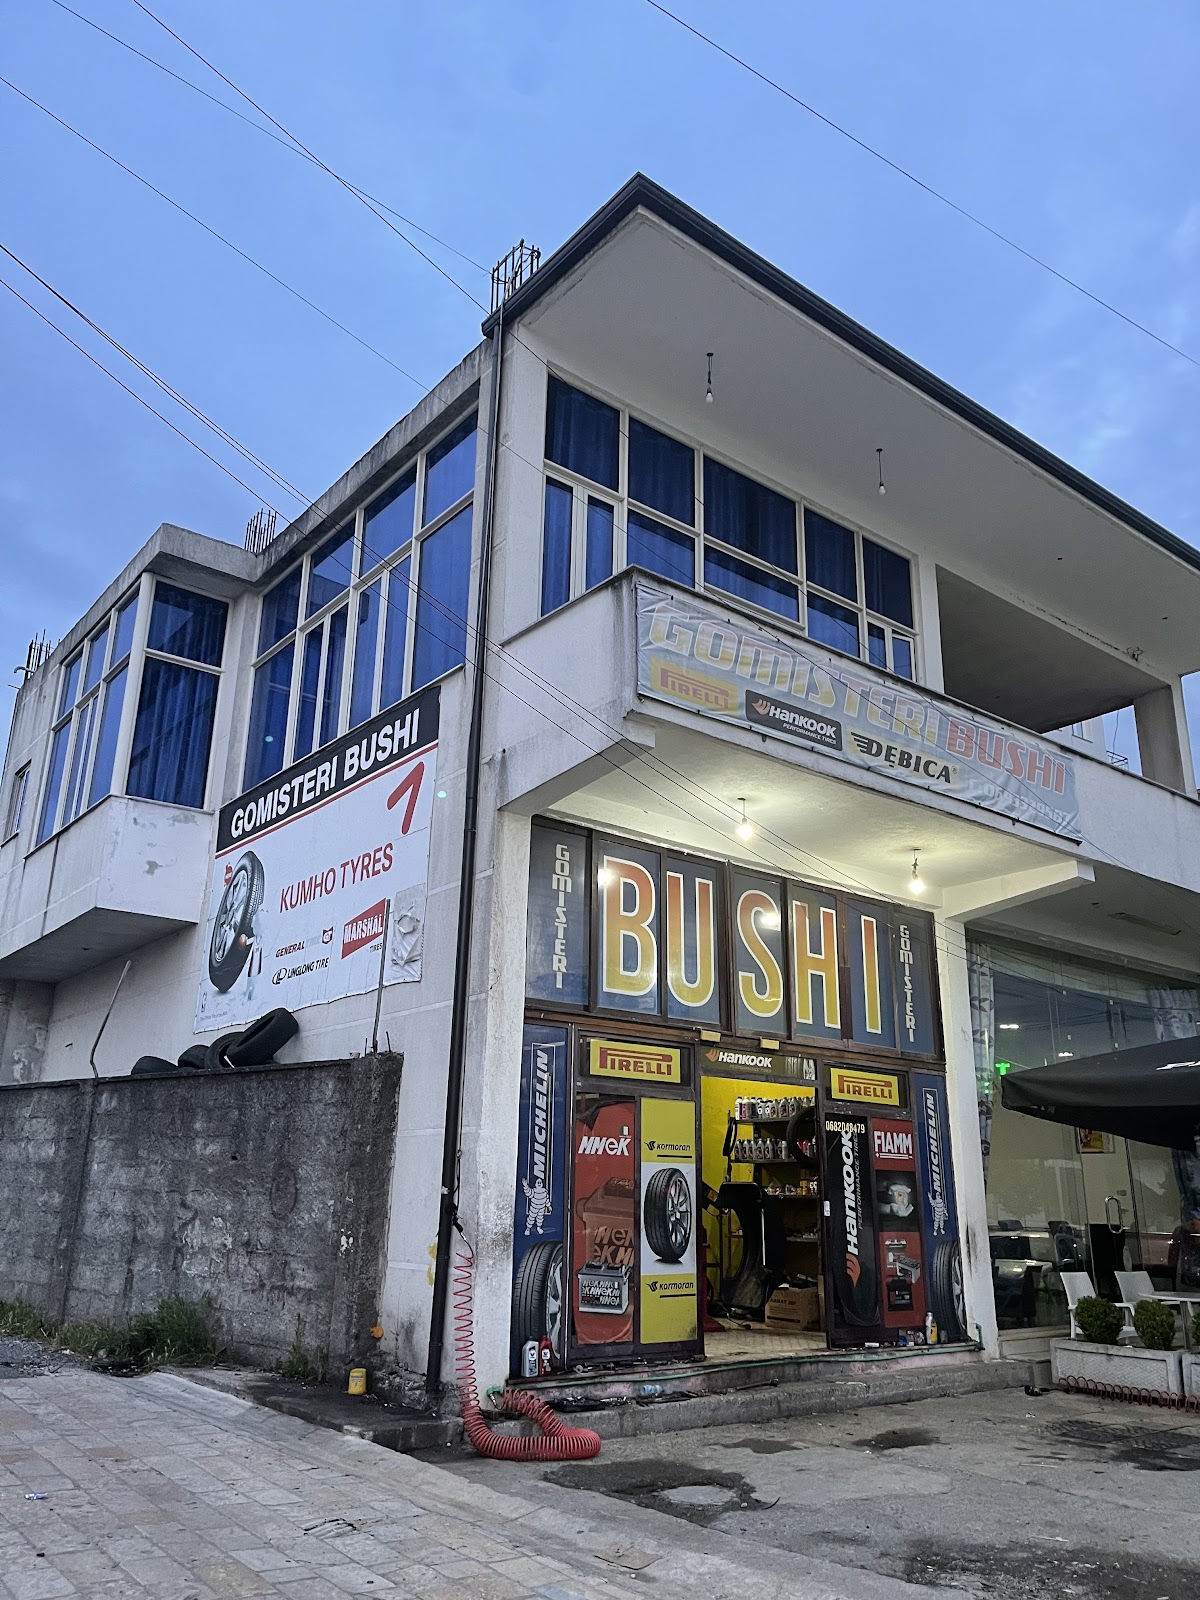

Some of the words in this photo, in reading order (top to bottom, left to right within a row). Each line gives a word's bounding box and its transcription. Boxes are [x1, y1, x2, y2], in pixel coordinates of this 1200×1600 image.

[649, 604, 940, 746] GOMISTERI
[660, 667, 729, 709] PIRELLI
[782, 722, 821, 740] PERFORMANCE
[822, 735, 837, 745] TIRES
[946, 717, 1066, 795] BUSHI
[230, 755, 338, 839] GOMISTERI
[343, 708, 420, 782] BUSHI
[279, 867, 337, 913] KUMHO
[340, 842, 394, 889] TYRES
[275, 940, 305, 958] GENERAL
[344, 913, 383, 944] MARSHAL
[369, 942, 383, 953] TIRES
[552, 843, 572, 989] GOMISTERI
[602, 854, 882, 1034] BUSHI
[287, 960, 315, 979] LINGLONG
[315, 957, 330, 971] TIRE
[899, 924, 917, 1043] GOMISTERI
[599, 1046, 673, 1076] PIRELLI
[837, 1074, 893, 1099] PIRELLI
[533, 1049, 549, 1180] MICHELIN
[873, 1130, 913, 1155] FIAMM
[926, 1092, 945, 1196] MICHELIN
[854, 1160, 863, 1230] PERFORMANCE
